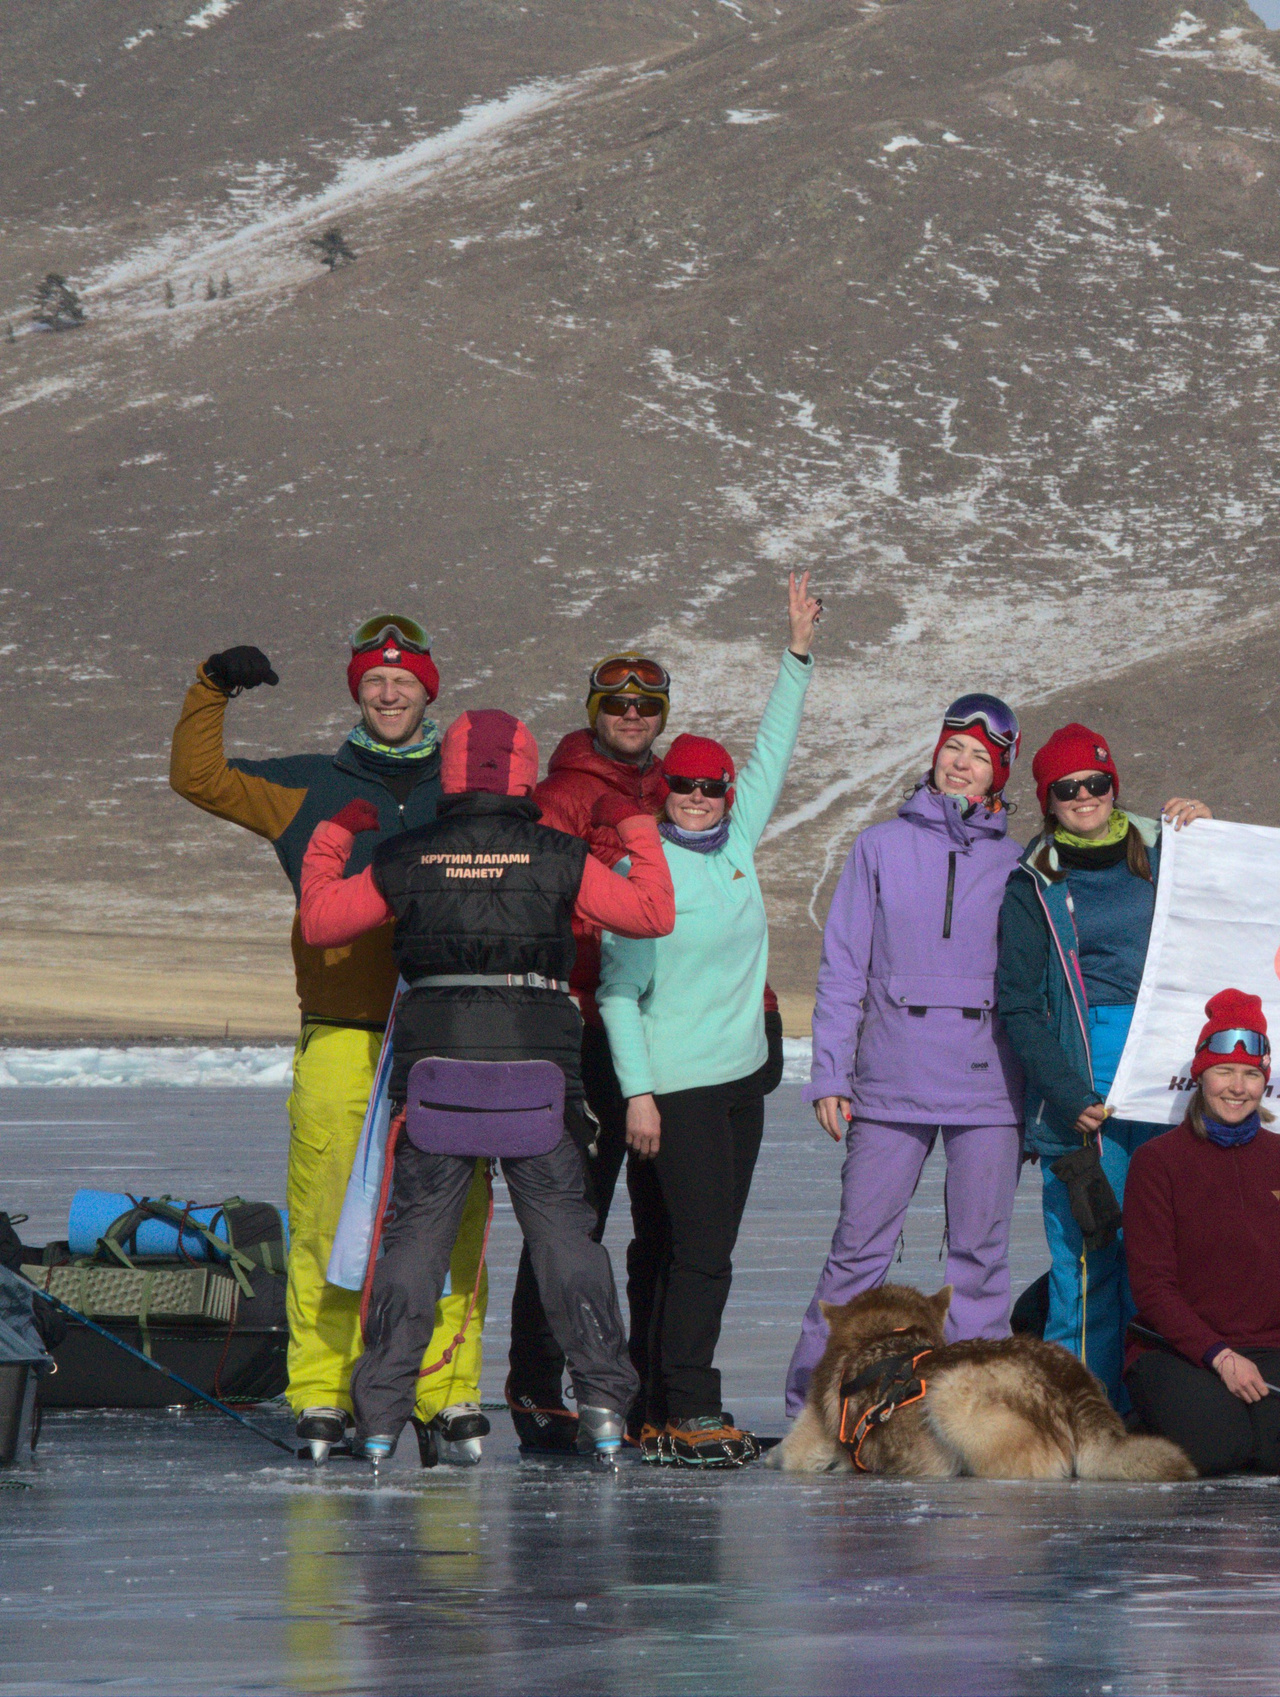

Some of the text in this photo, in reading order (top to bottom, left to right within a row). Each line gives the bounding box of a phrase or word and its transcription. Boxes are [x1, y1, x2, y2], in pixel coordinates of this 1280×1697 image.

[421, 853, 530, 865] КРУТИМ ЛАПАМИ
[446, 868, 503, 879] ПЛАНЕТУ
